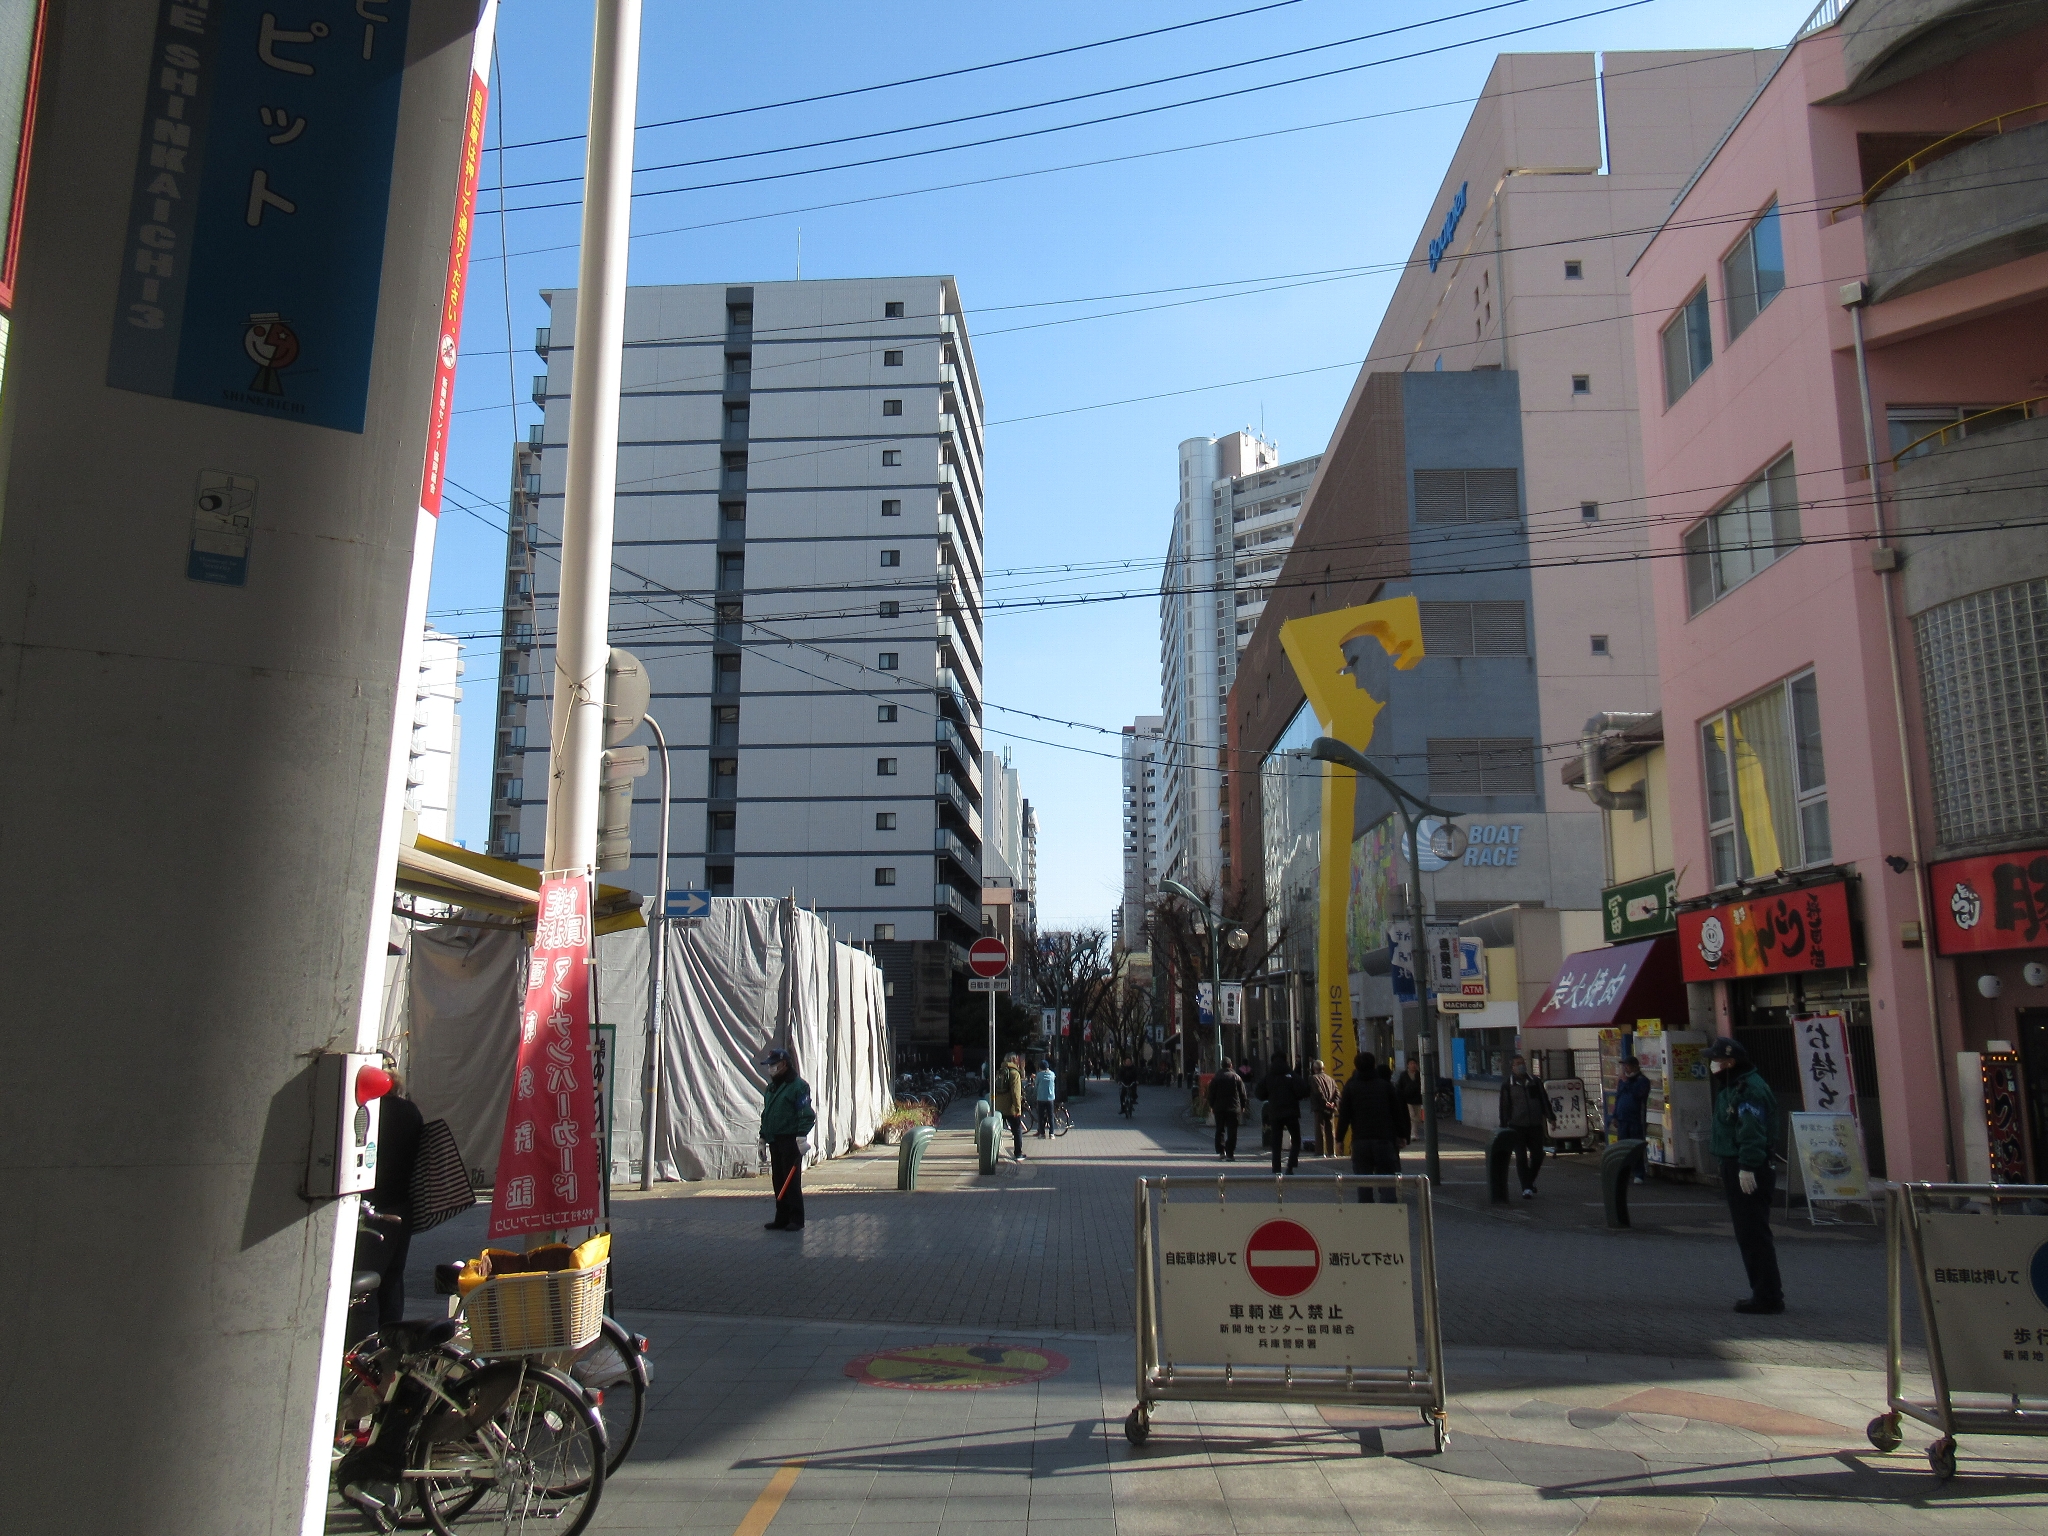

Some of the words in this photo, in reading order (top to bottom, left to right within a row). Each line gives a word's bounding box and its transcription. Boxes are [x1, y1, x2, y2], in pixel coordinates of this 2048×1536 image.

[1467, 824, 1524, 845] BOAT
[1462, 846, 1520, 868] RACE
[1462, 984, 1484, 996] ATM
[1541, 963, 1627, 1014] 炭火焼肉
[1444, 1001, 1467, 1010] MACHI
[1809, 1138, 1847, 1148] らーめん
[1165, 1251, 1237, 1266] 自転車は押して
[1328, 1251, 1404, 1266] 通行して下さい
[1934, 1267, 2020, 1285] 自転車は押して
[1219, 1323, 1356, 1336] 新開地センター協同組合
[1258, 1338, 1317, 1350] 兵庫警察署
[2003, 1349, 2044, 1362] 新開地
